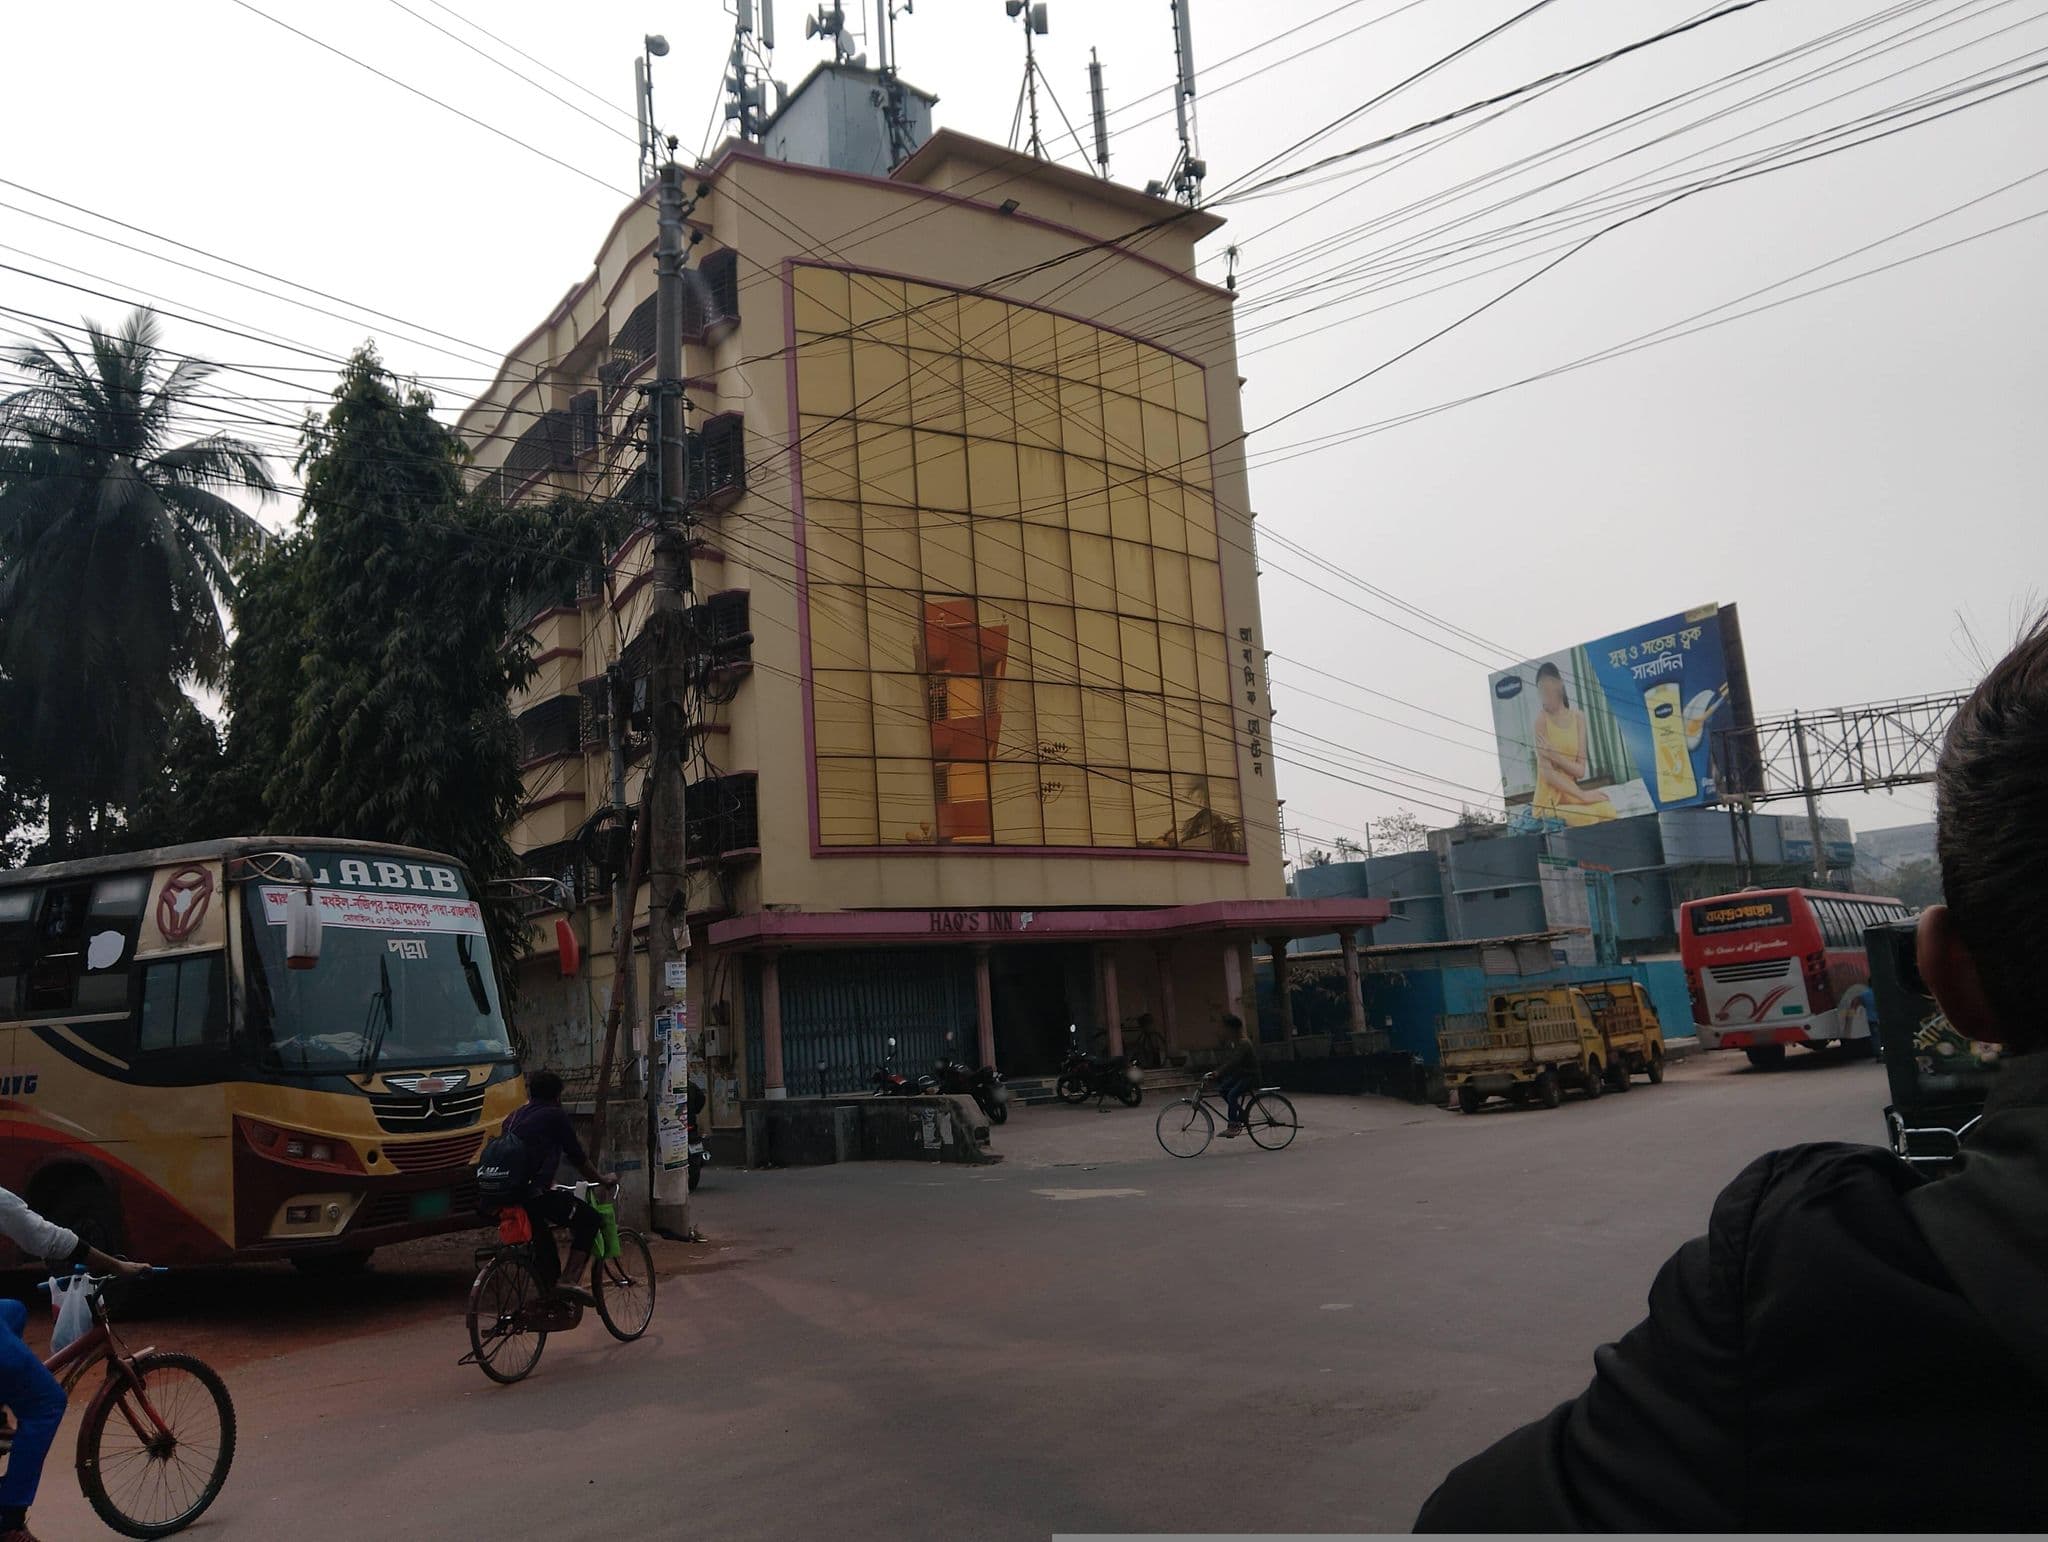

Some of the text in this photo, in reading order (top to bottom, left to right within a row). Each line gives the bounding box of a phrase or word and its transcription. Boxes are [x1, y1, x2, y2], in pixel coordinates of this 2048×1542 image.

[1629, 646, 1639, 659] ও
[1640, 634, 1676, 655] সতেজ
[1679, 626, 1702, 650] ত্বক
[1630, 651, 1684, 680] সারাদিন
[1239, 627, 1263, 778] আবাসিক হোটেল
[339, 859, 459, 893] ABIB
[930, 911, 1013, 932] HAQ'S INN
